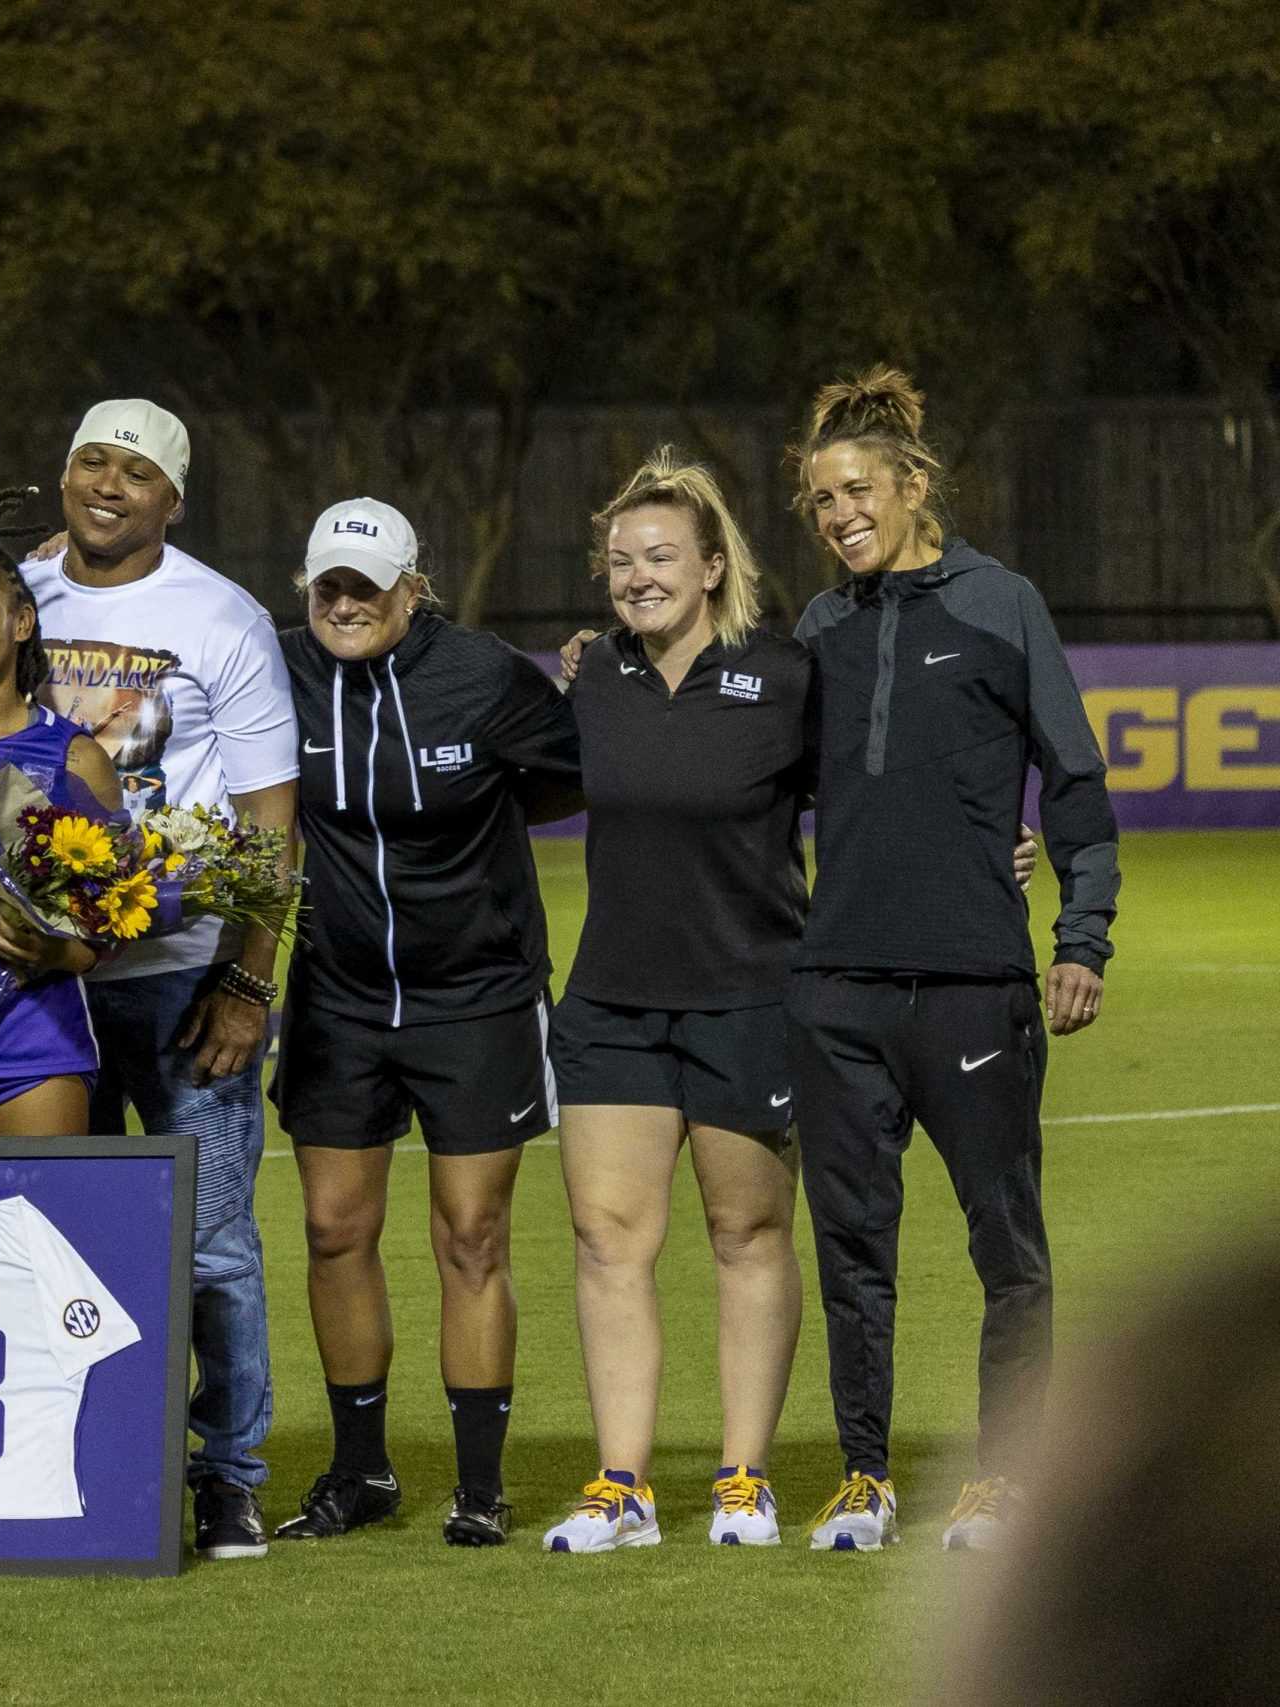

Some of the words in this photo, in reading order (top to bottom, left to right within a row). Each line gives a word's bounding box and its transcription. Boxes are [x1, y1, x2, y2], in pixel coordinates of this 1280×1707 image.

[114, 428, 139, 444] LSU
[333, 520, 378, 538] LSU
[44, 648, 172, 690] ENDARY
[720, 670, 762, 693] LSU
[719, 687, 759, 701] SOCCER
[419, 742, 473, 767] LSU
[64, 1300, 100, 1338] SEC
